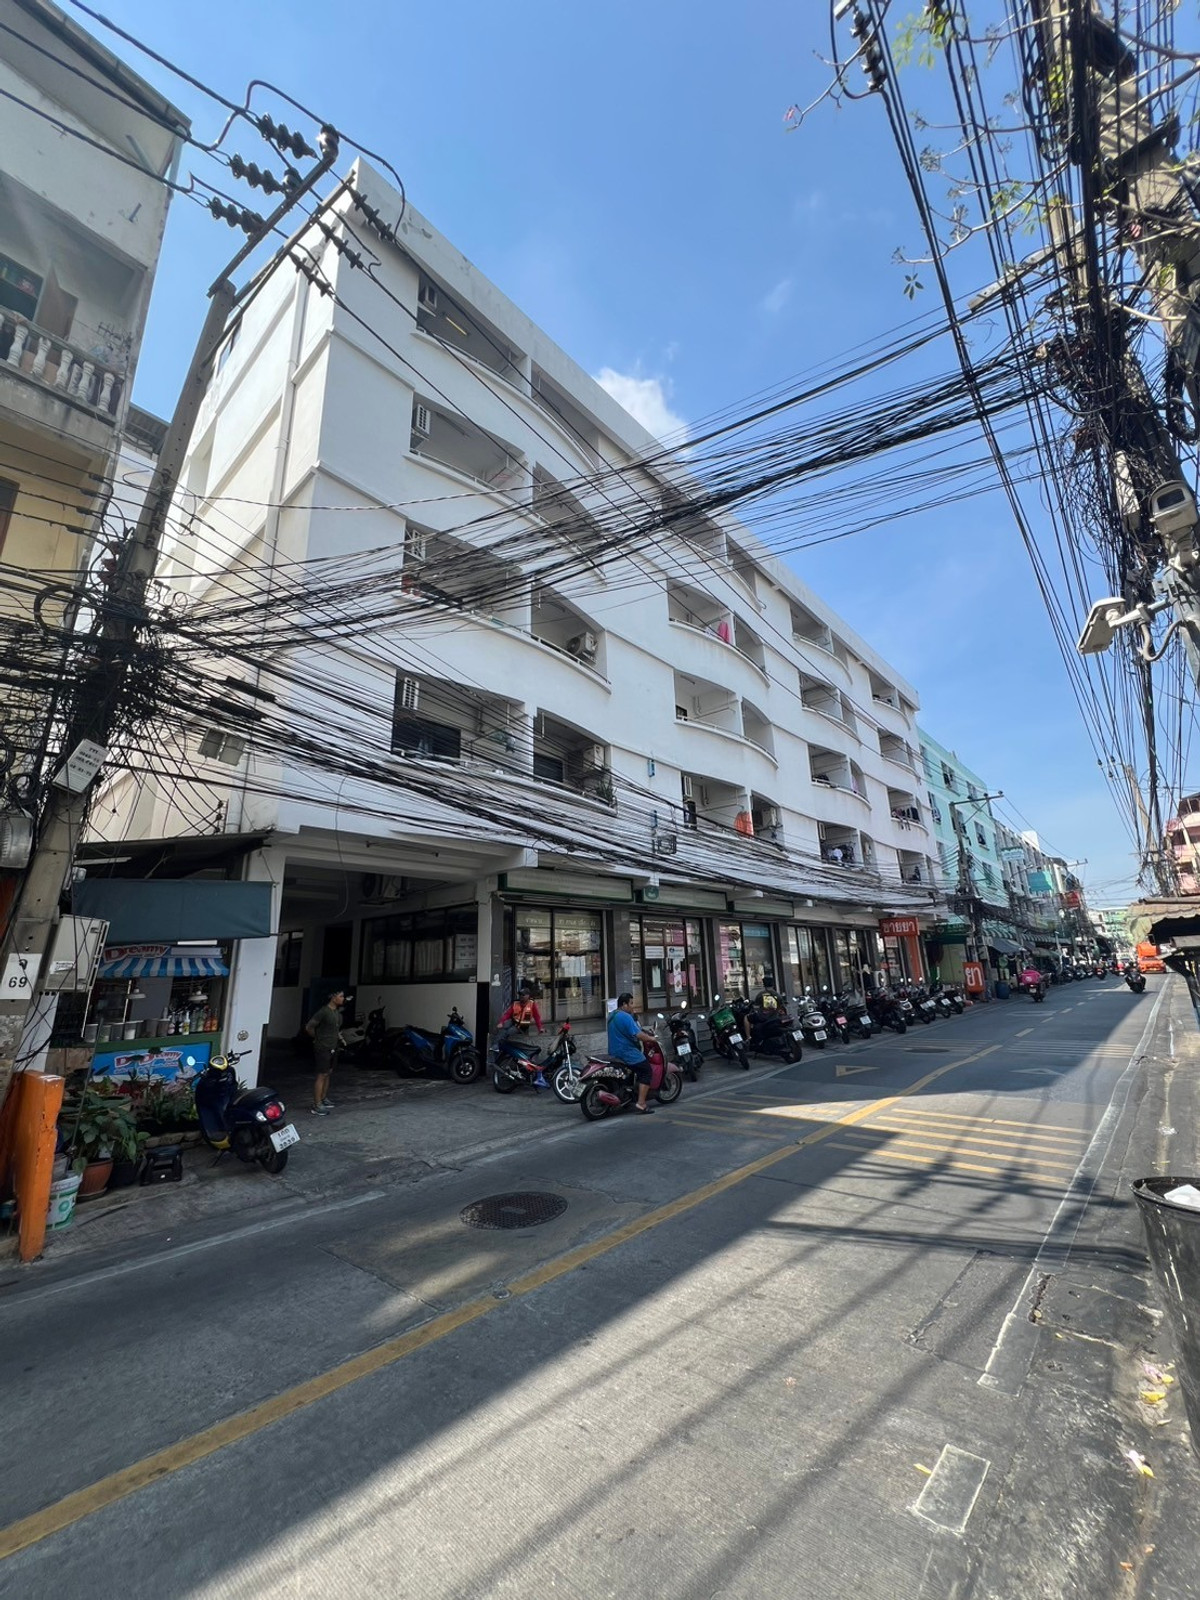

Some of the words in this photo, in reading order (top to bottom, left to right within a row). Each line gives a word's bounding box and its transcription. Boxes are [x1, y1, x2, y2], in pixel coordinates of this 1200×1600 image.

[882, 921, 916, 933] ขายยา
[105, 945, 167, 961] Dreamy
[8, 976, 28, 988] 69
[965, 967, 983, 987] ยา
